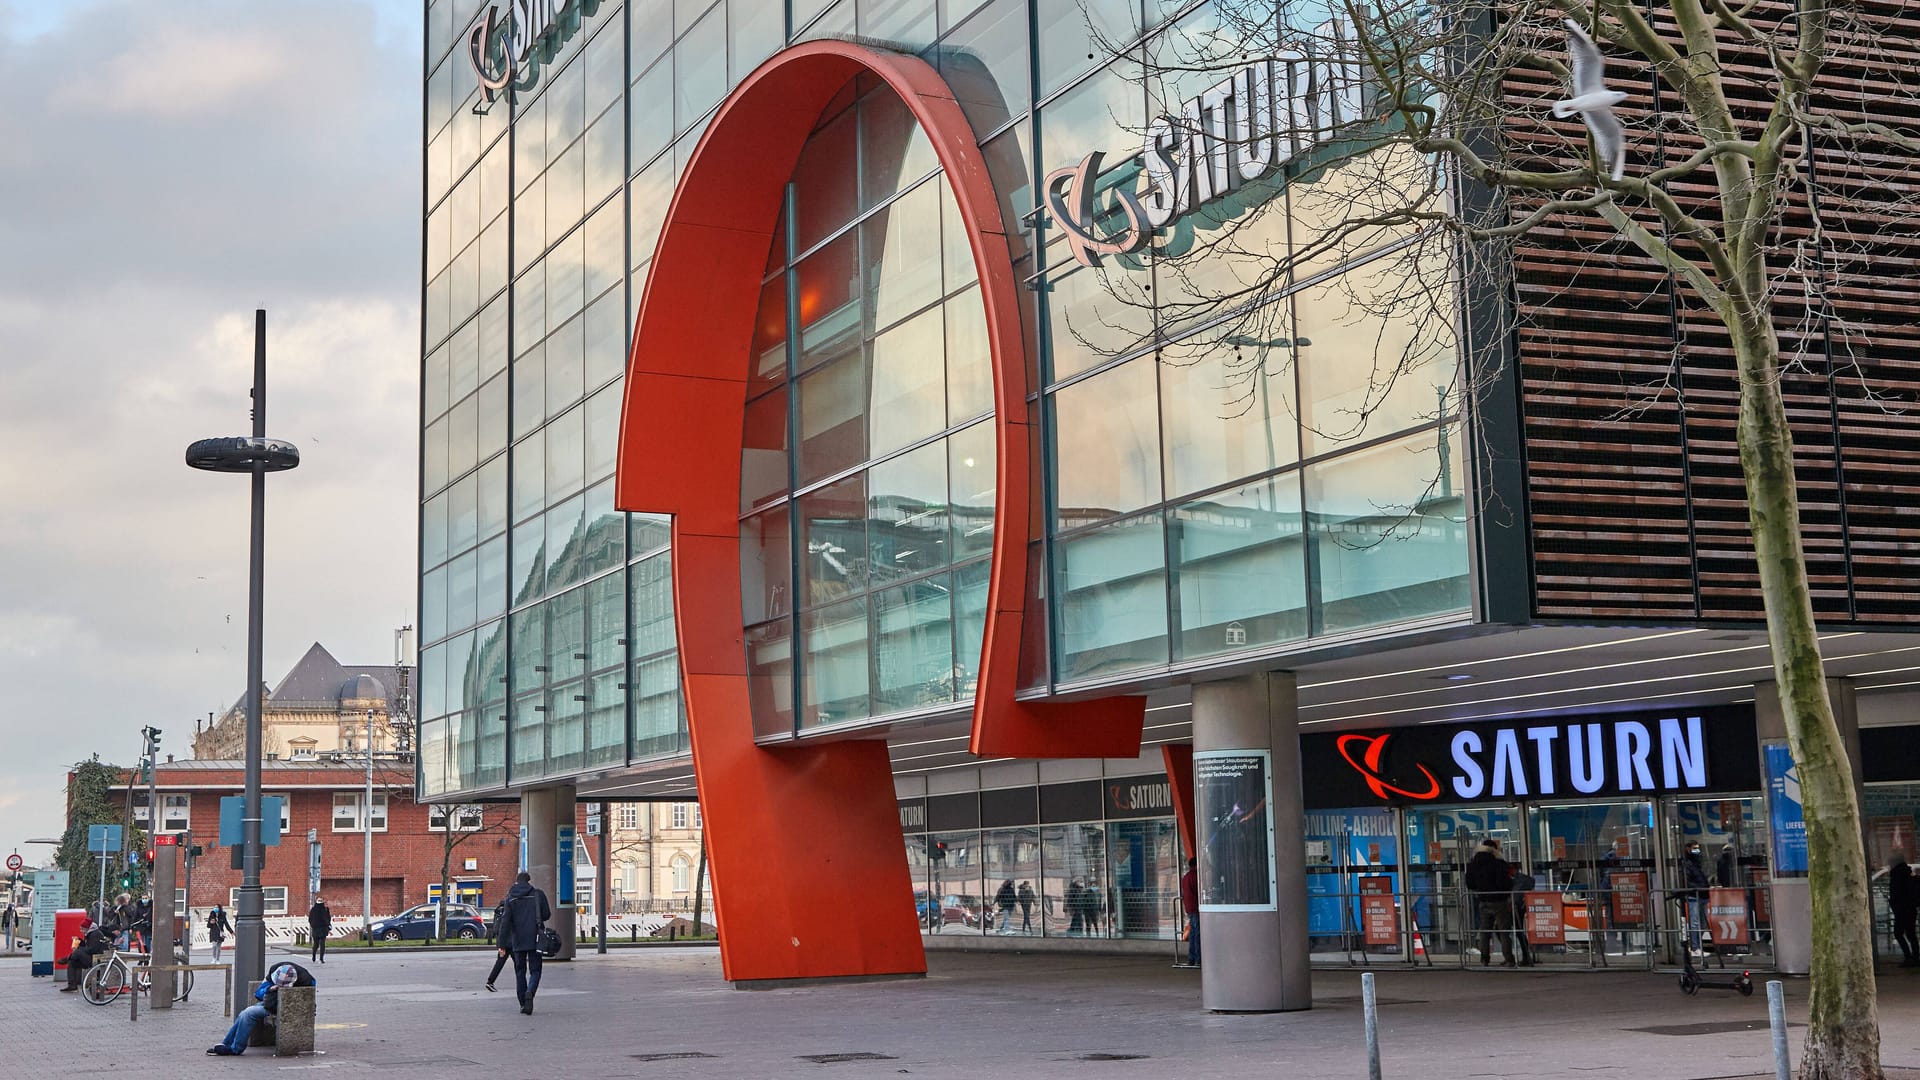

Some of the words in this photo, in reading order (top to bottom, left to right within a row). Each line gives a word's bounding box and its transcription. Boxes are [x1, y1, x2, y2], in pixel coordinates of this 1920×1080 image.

[1145, 12, 1366, 228] SATURN
[1450, 716, 1707, 799] SATURN
[898, 805, 924, 827] ATURN
[1130, 783, 1171, 810] SATURN
